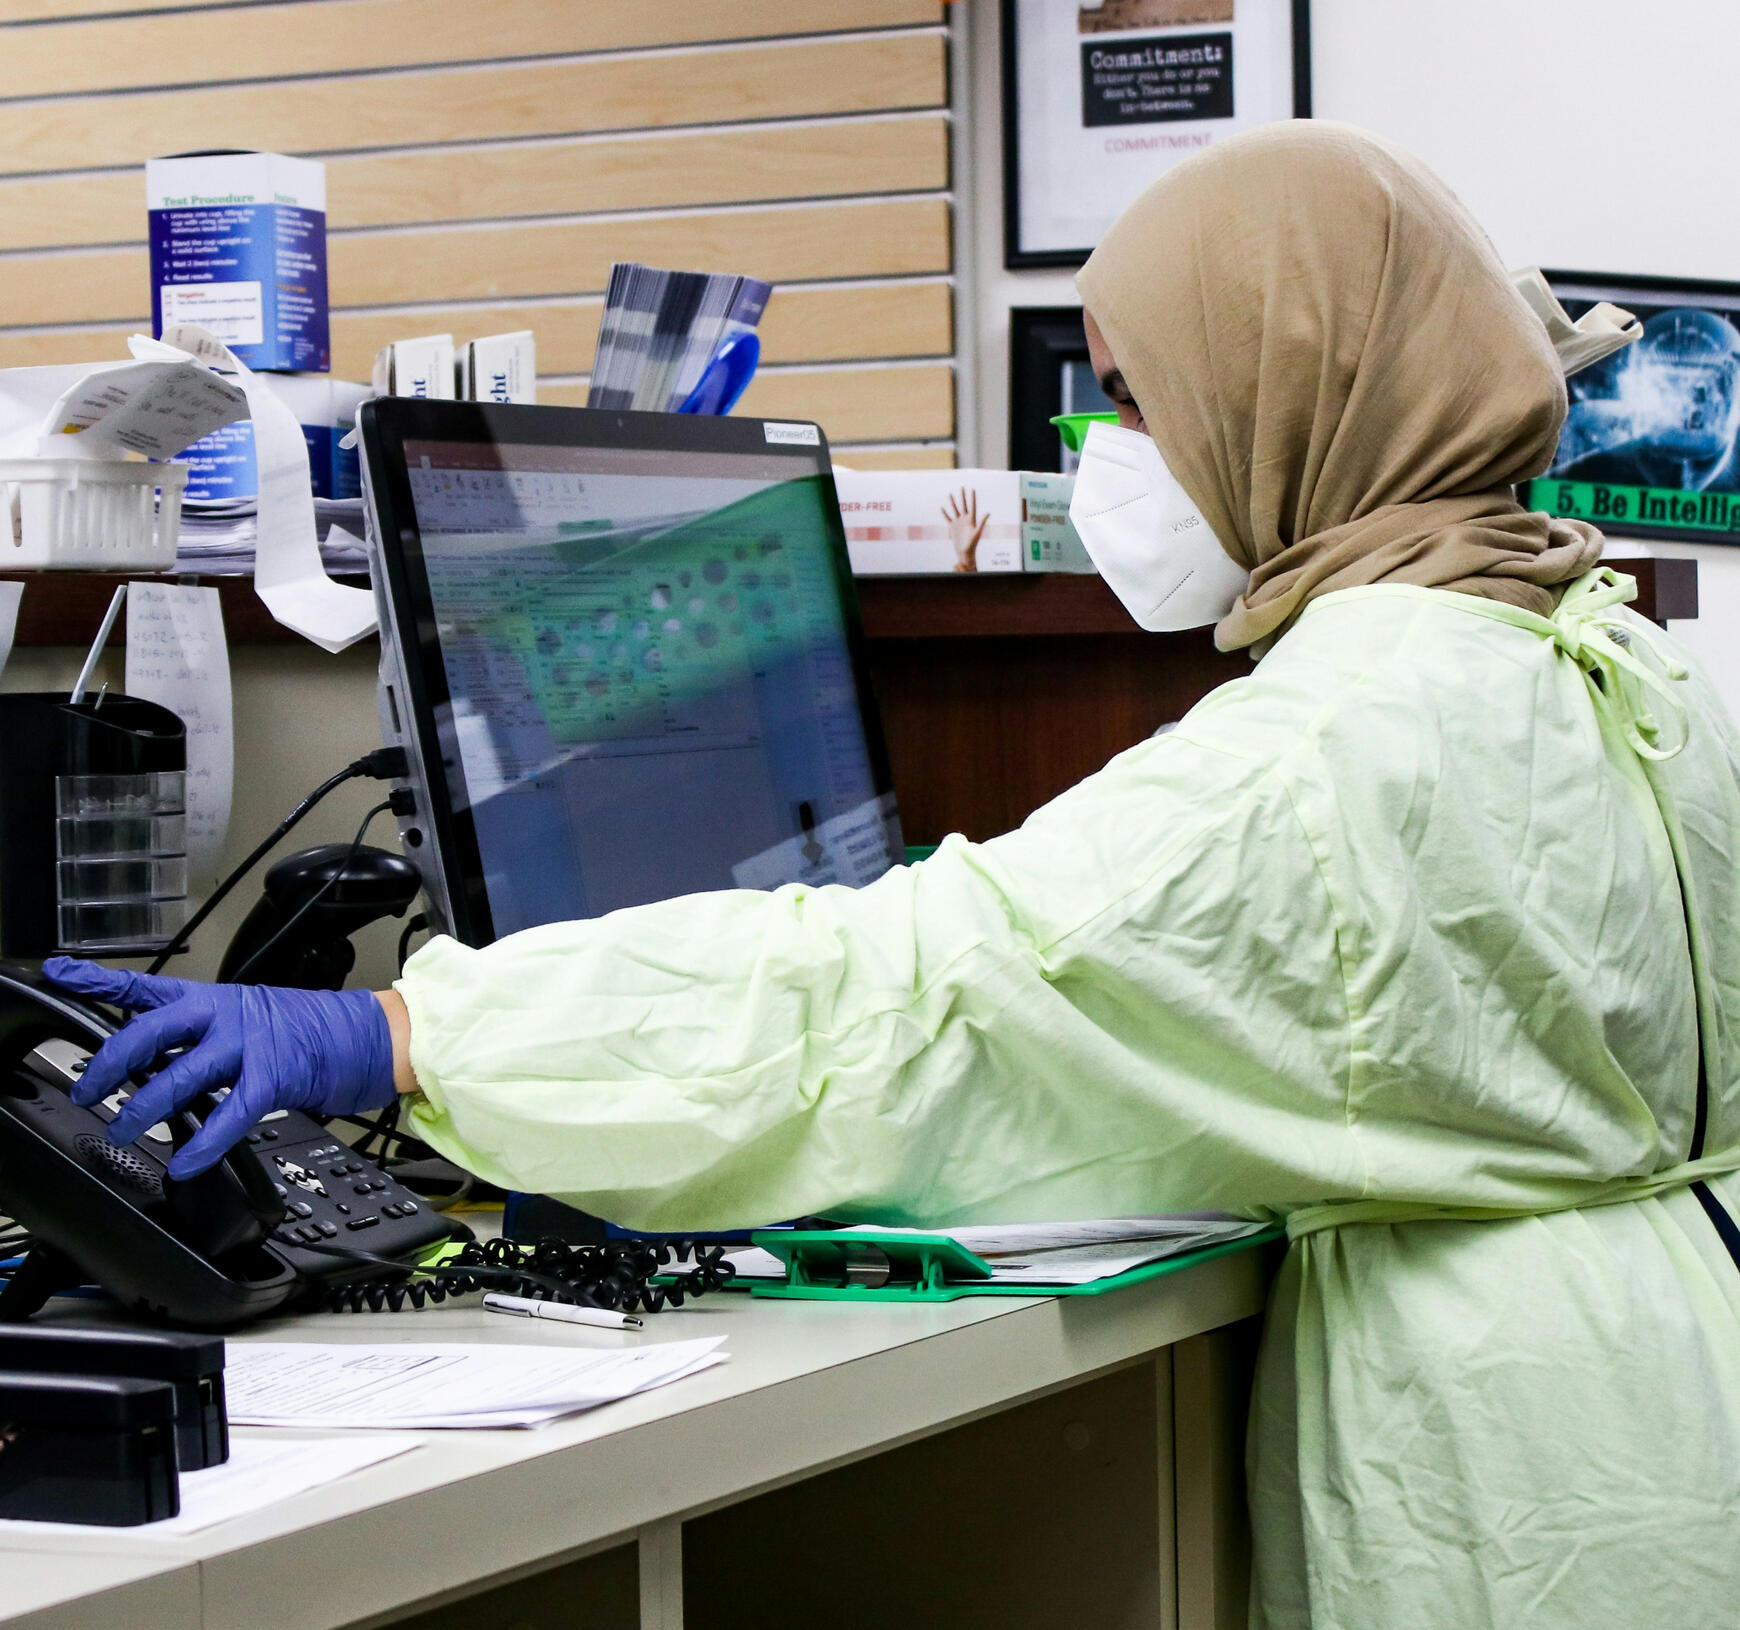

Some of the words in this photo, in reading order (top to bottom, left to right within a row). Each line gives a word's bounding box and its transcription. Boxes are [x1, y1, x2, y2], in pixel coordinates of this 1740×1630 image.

[1090, 44, 1223, 70] Commitment:
[1104, 132, 1212, 153] COMMITMENT
[162, 197, 187, 206] Test
[190, 194, 254, 205] Procedure
[1557, 484, 1581, 515] 5.
[1592, 487, 1628, 518] Be
